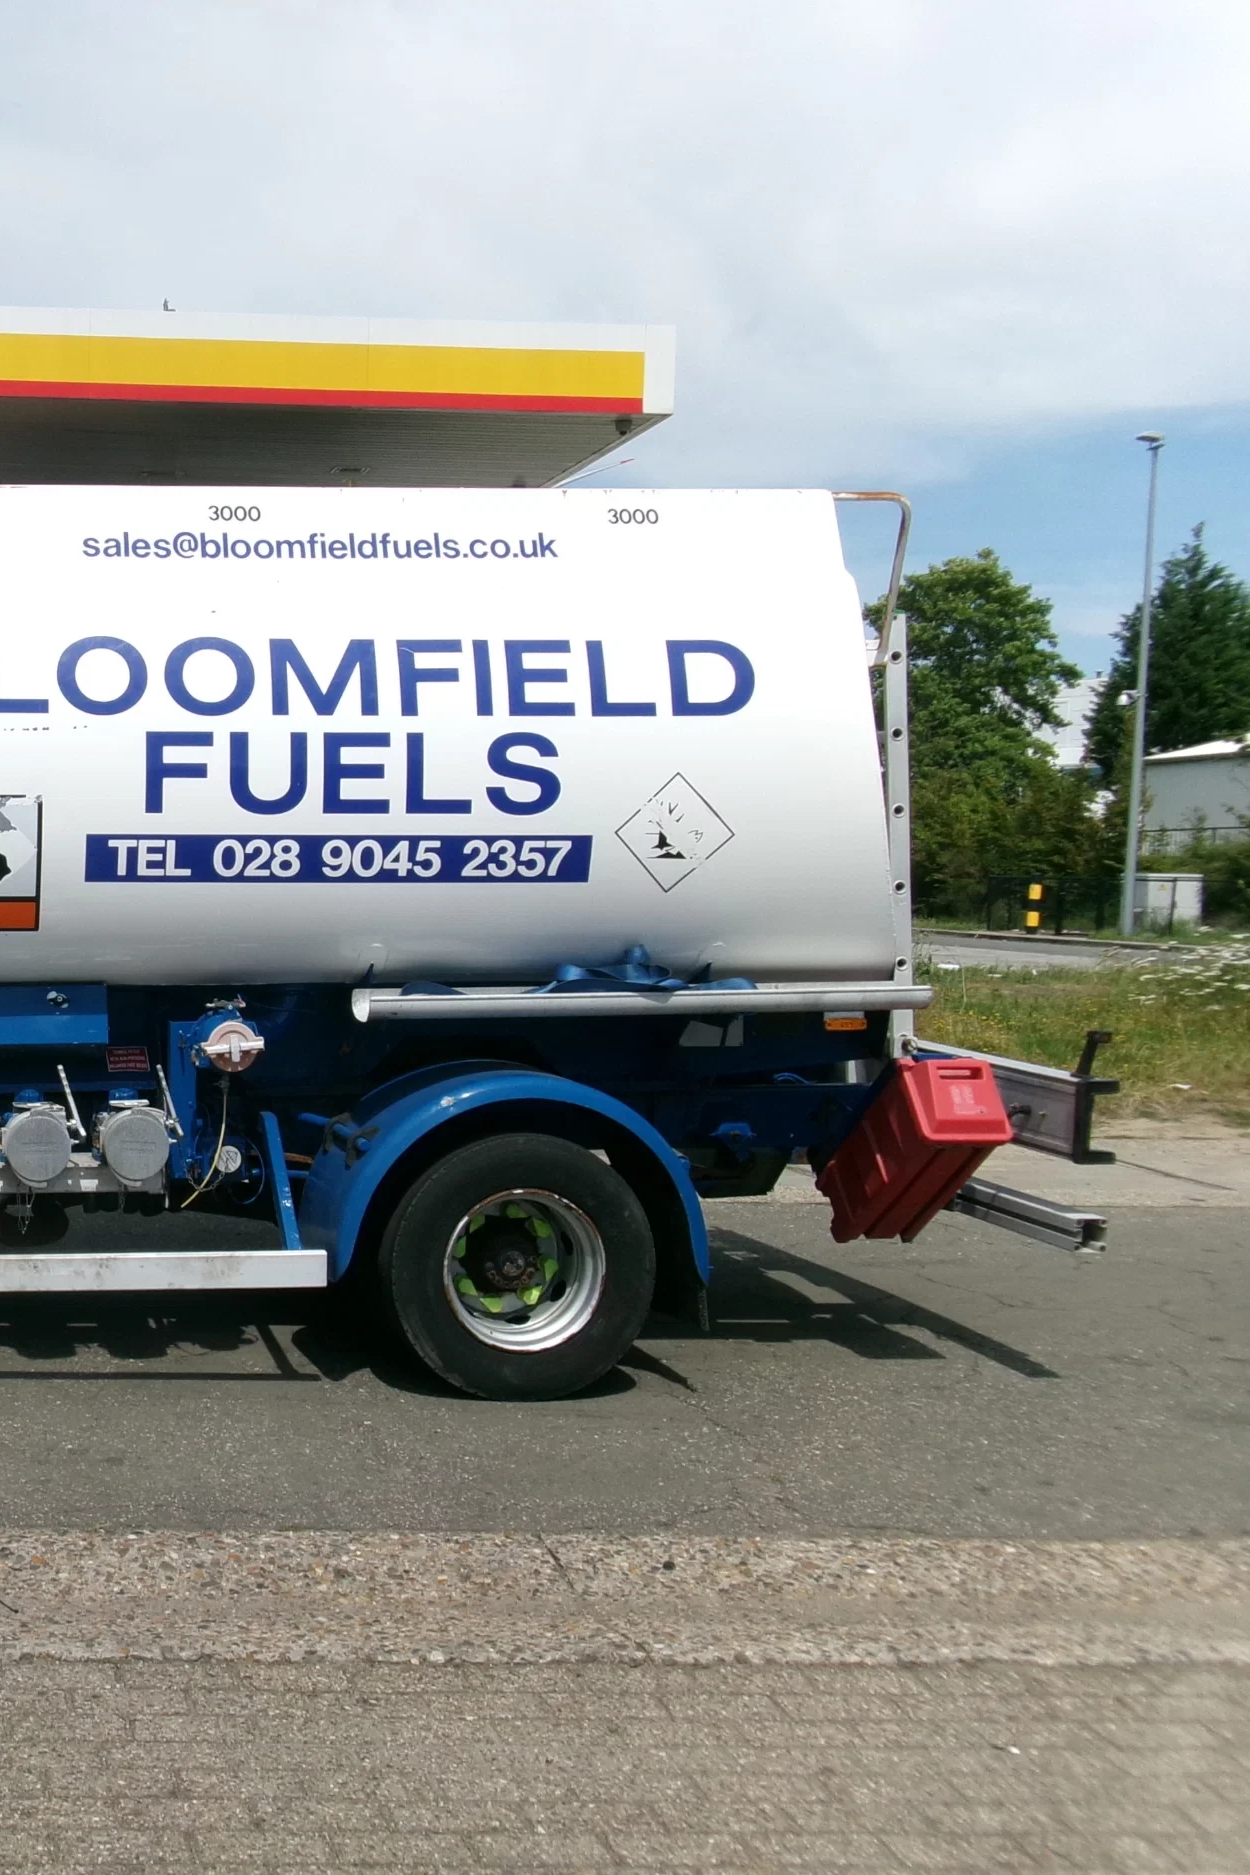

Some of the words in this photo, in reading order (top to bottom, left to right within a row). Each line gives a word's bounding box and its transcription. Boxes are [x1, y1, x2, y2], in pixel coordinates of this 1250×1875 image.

[208, 505, 261, 522] 3000
[607, 508, 659, 525] 3000
[82, 531, 559, 560] sales@bloomfieldfuels.co.uk
[144, 730, 562, 817] FUELS
[108, 839, 192, 877] TEL
[213, 838, 301, 878] 028
[321, 839, 442, 878] 9045
[461, 839, 572, 878] 2357
